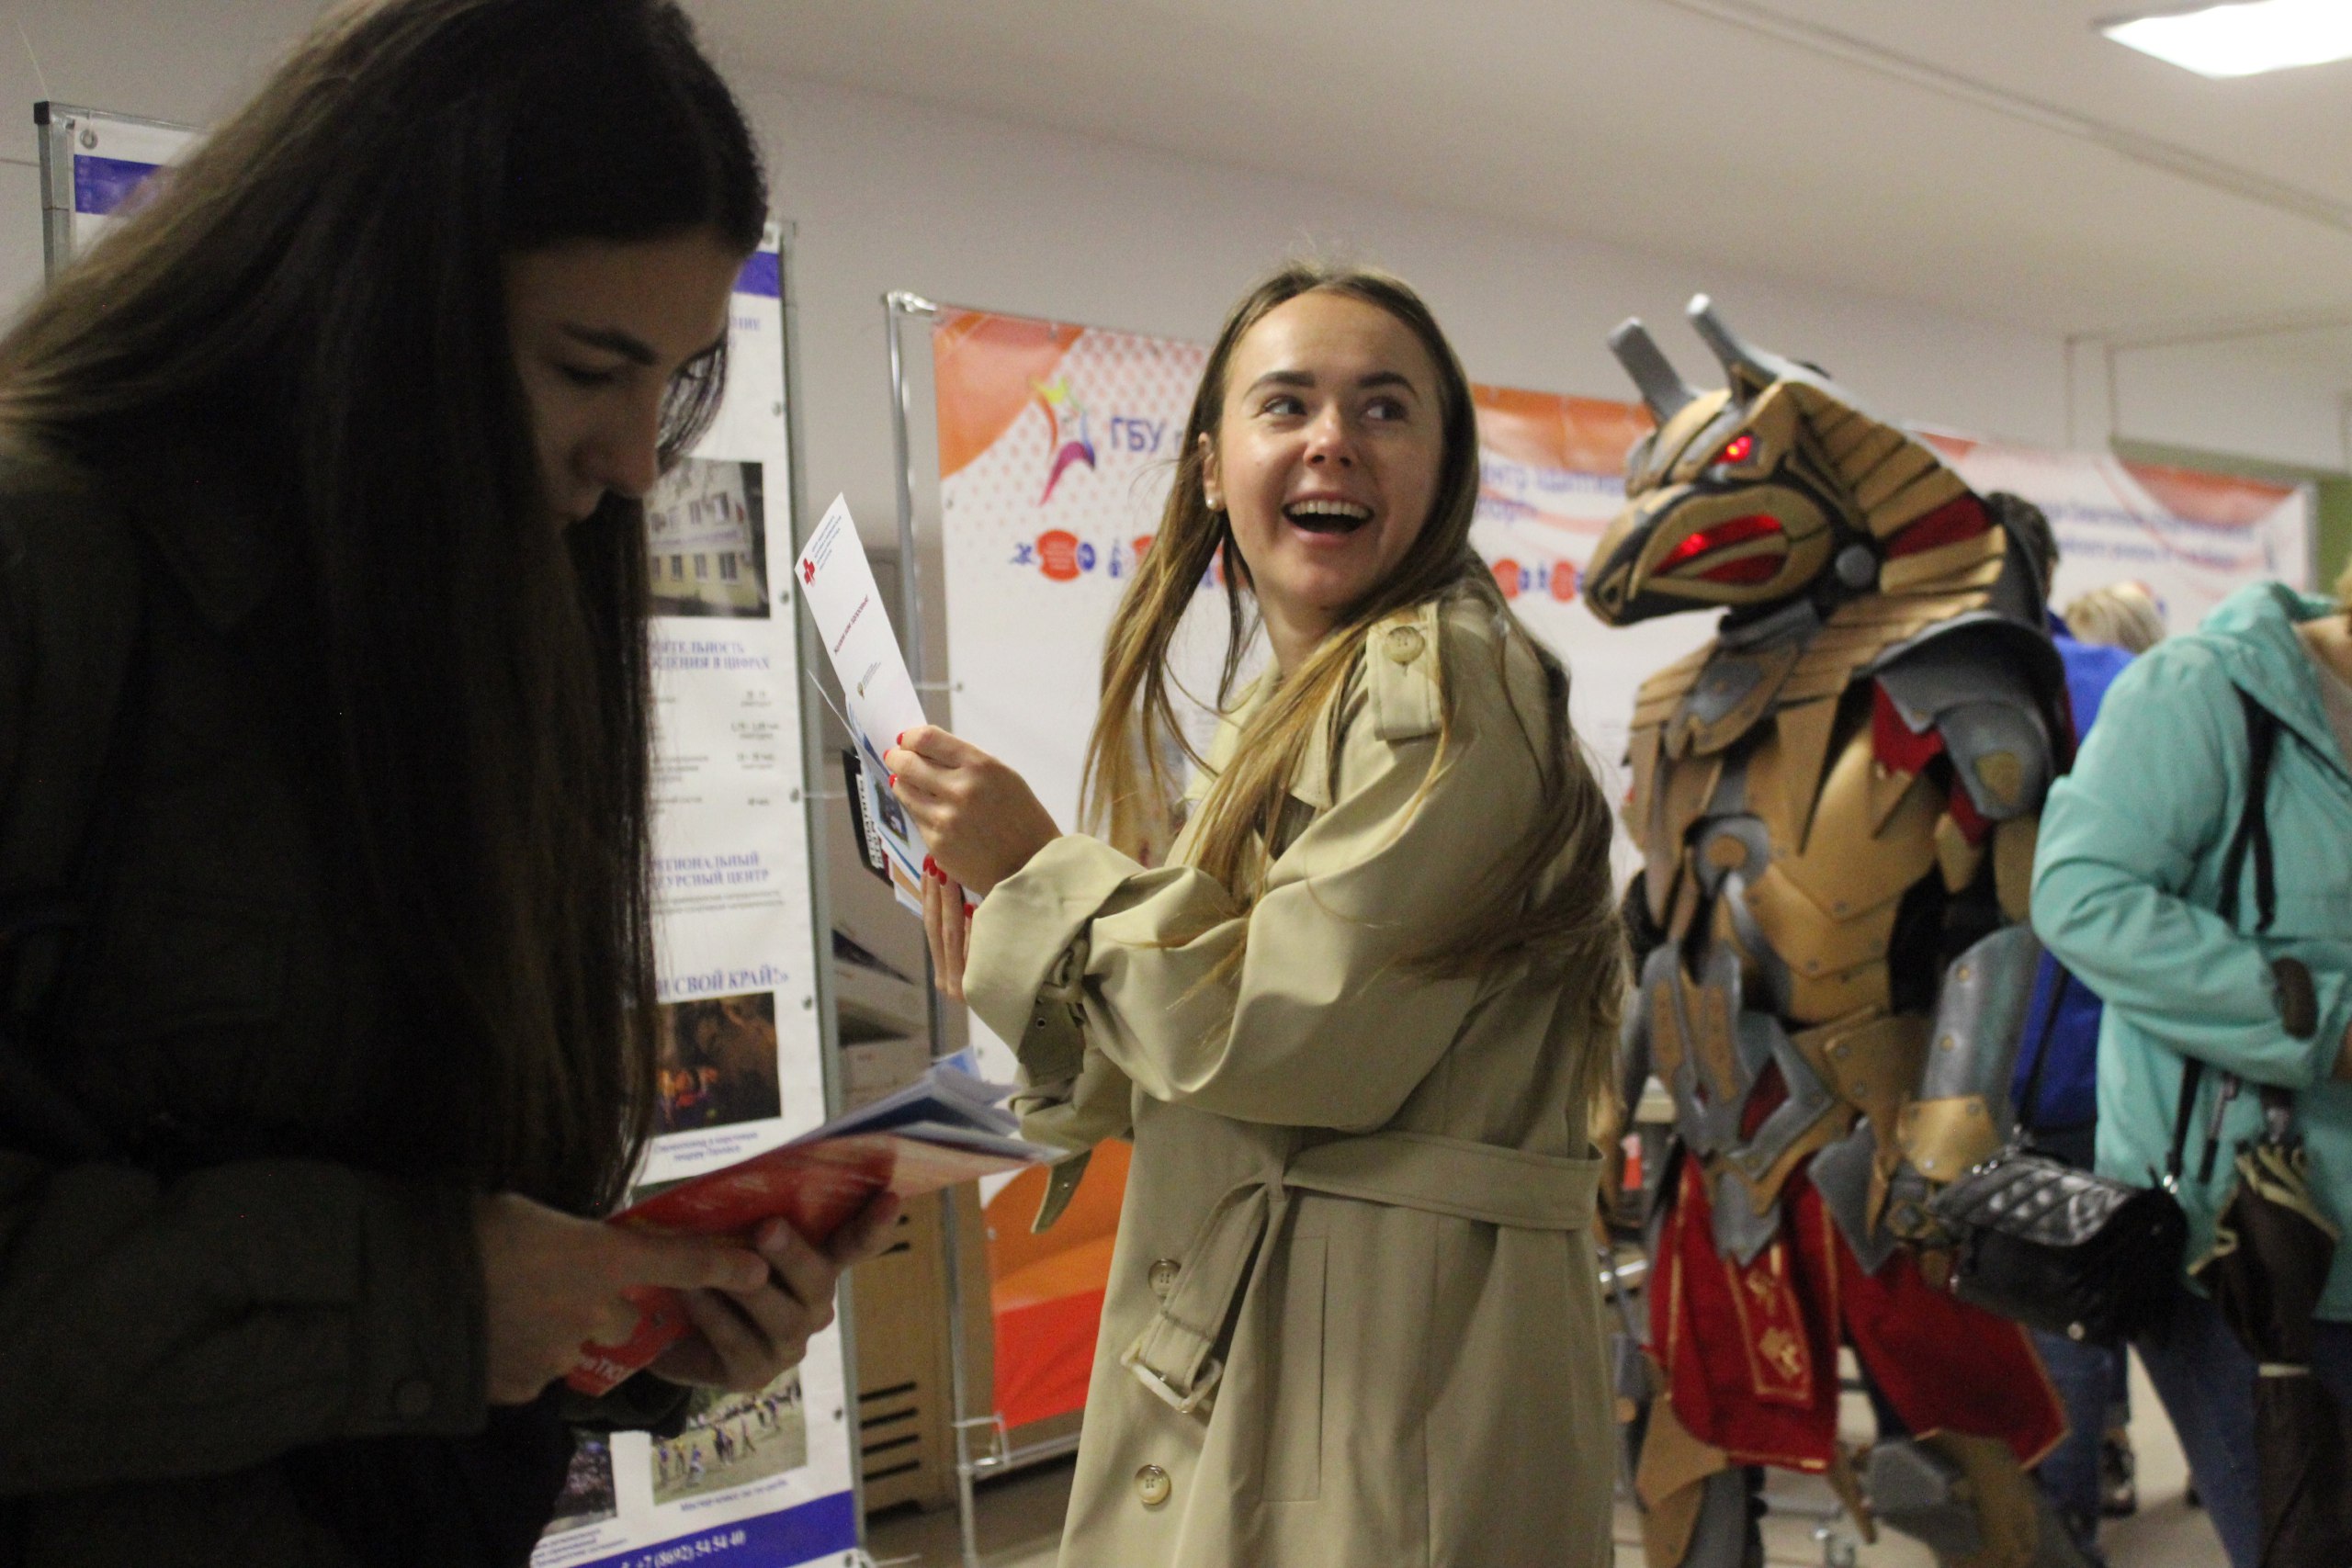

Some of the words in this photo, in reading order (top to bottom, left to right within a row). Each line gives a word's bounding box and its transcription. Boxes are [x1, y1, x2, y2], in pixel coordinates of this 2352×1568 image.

[1109, 416, 1166, 453] ГБУ
[727, 868, 769, 885] ЦЕНТР
[674, 968, 723, 995] СВОЙ
